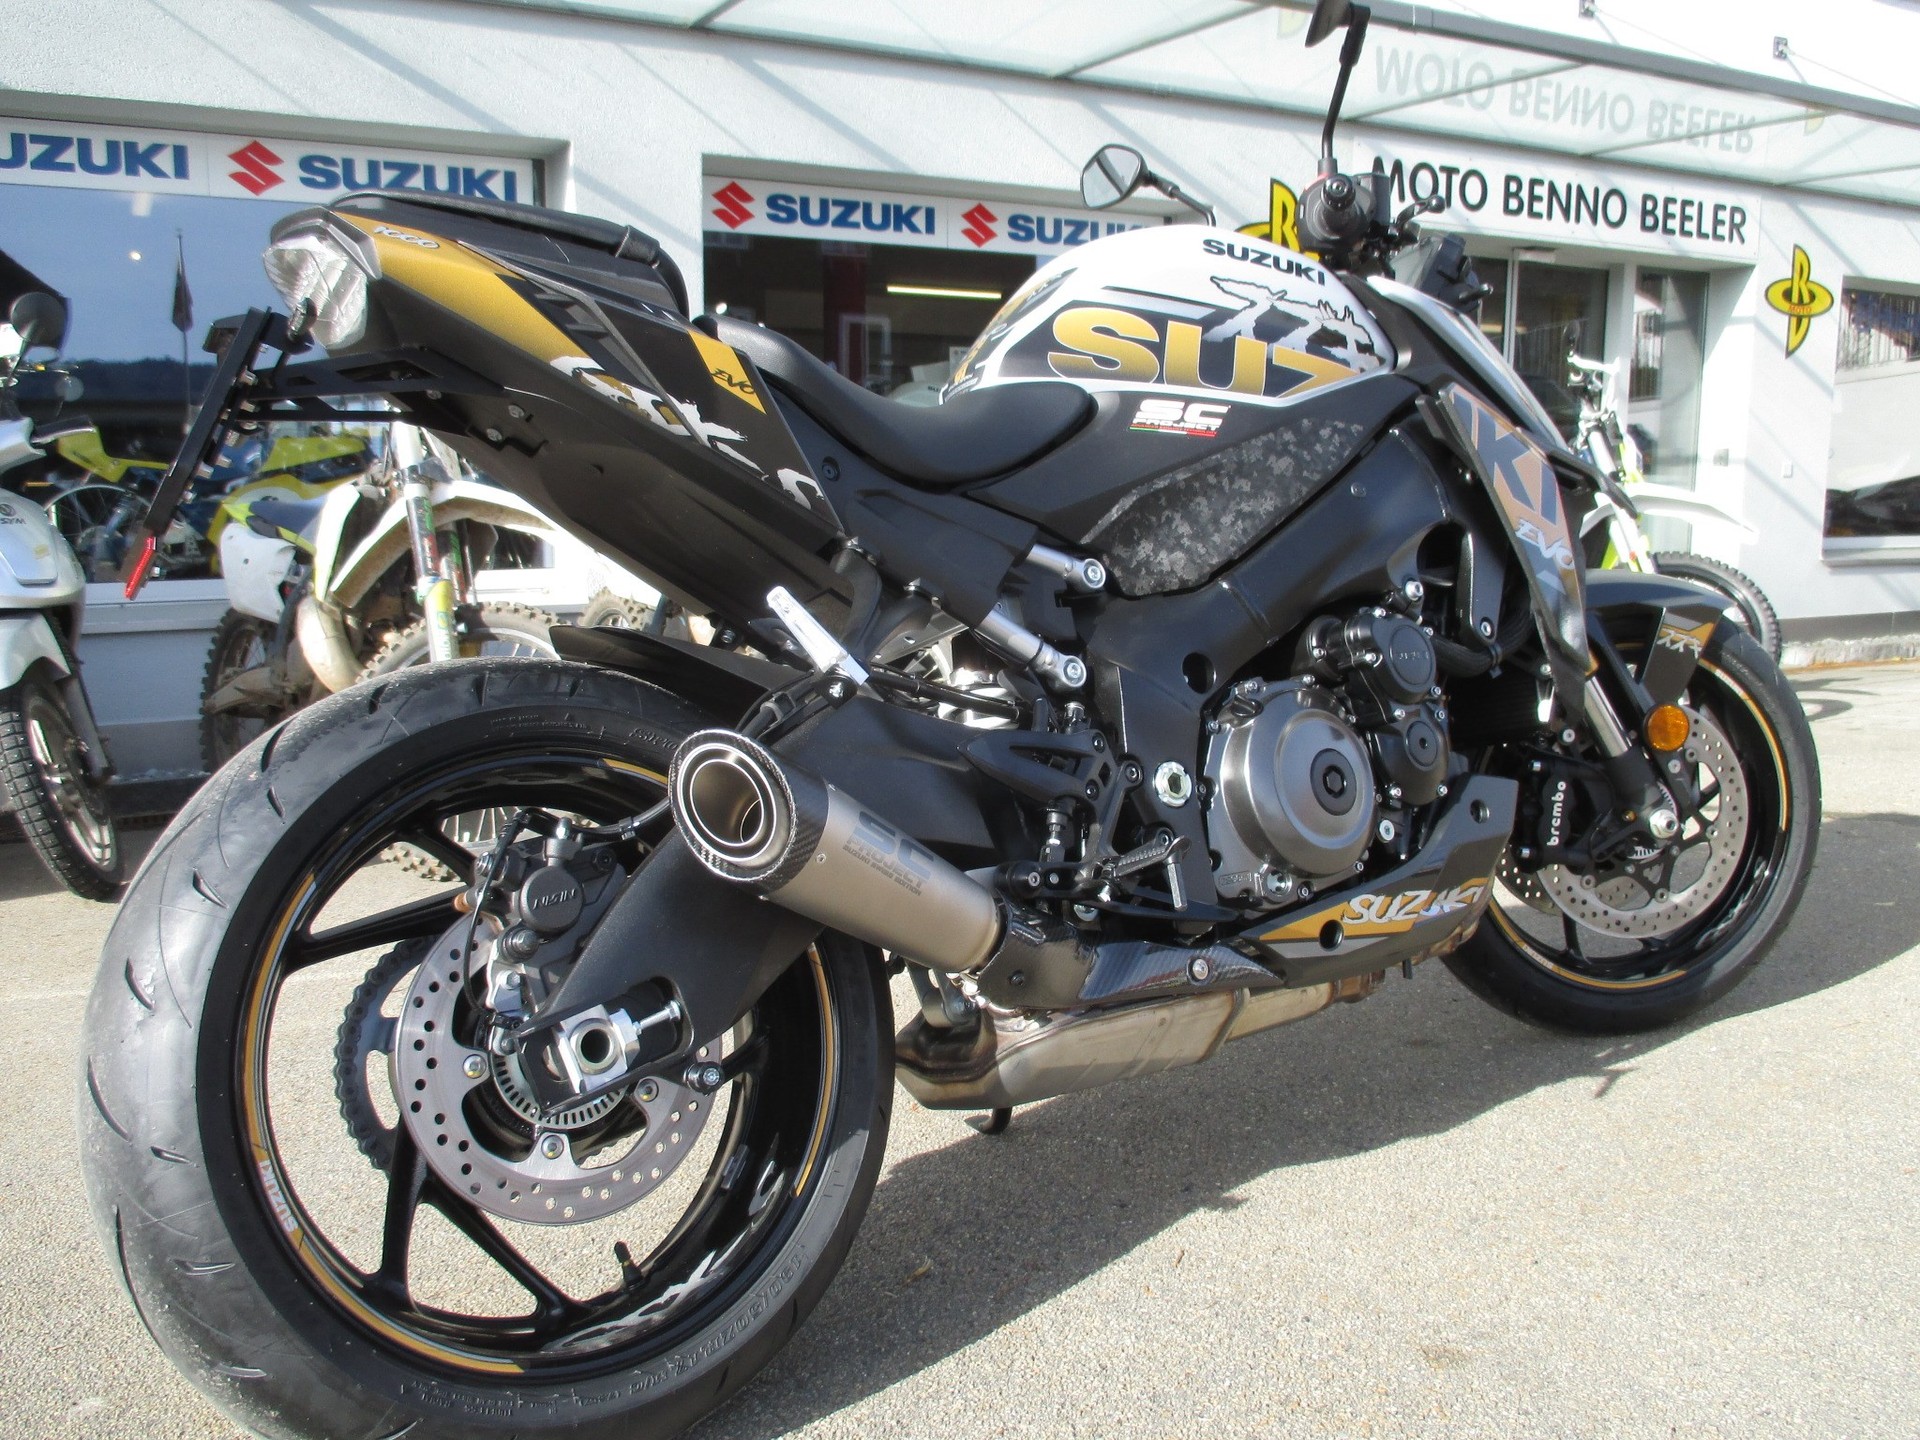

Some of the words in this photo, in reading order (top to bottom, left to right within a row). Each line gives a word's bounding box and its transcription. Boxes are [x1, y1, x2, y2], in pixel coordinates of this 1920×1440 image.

[298, 155, 518, 203] SUZUKI
[1371, 156, 1488, 211] MOTO
[1503, 175, 1628, 228] BENNO
[1640, 194, 1747, 244] BEELER
[373, 225, 441, 249] 1000
[766, 193, 936, 235] SUZUKI
[1007, 213, 1148, 246] SUZ
[1203, 238, 1326, 286] SUZUKI
[710, 367, 757, 395] EVO
[1135, 399, 1230, 426] SC
[1515, 518, 1576, 570] EVO
[1547, 781, 1566, 847] brembo
[853, 811, 935, 881] SC
[1342, 885, 1486, 924] SUZUKI
[259, 1159, 299, 1233] SUZUKI
